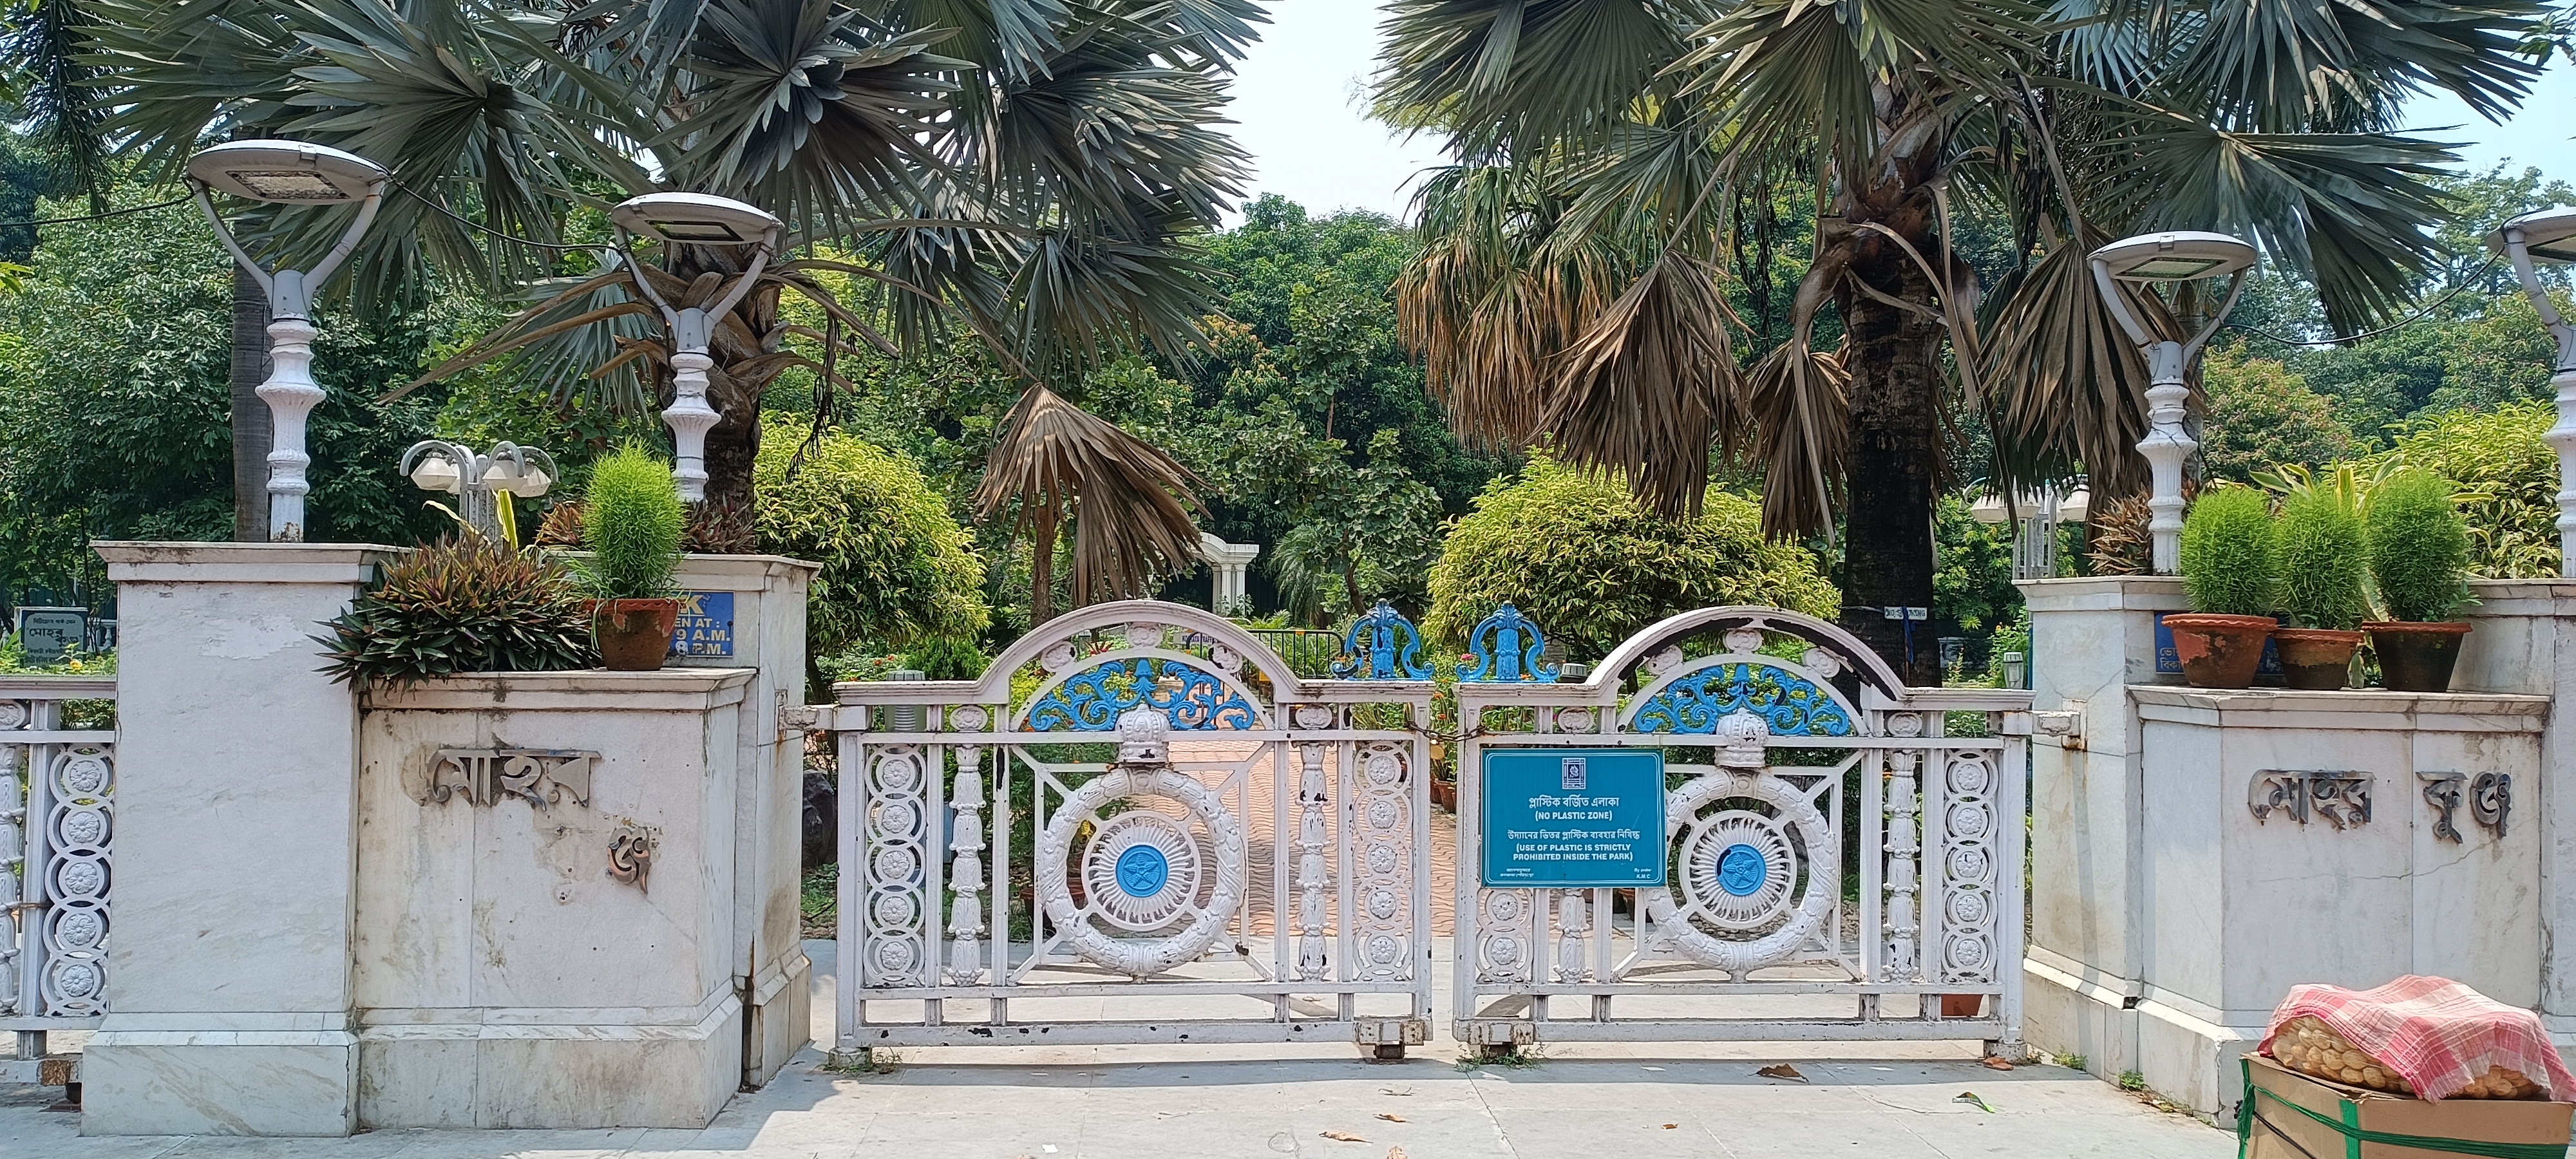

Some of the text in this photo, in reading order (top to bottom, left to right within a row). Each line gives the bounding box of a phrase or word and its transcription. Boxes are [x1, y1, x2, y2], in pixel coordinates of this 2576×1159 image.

[675, 618, 691, 627] EN
[695, 618, 713, 628] AT
[692, 629, 731, 641] A.M.
[692, 643, 726, 655] P.M.
[2159, 647, 2178, 656] ভো
[2159, 657, 2181, 670] বিকা
[1529, 794, 1620, 808] প্লাস্টিক বর্জিত এলাকা
[1535, 811, 1613, 821] (NO PLASTIC ZONE)
[1508, 829, 1640, 841] উদ্যানের ভিতর প্লাস্টিক ব্যবহার নিষিদ্ধ
[1516, 843, 1535, 853] (USE
[1594, 843, 1631, 852] STRICTLY
[1609, 852, 1633, 862] PARK)
